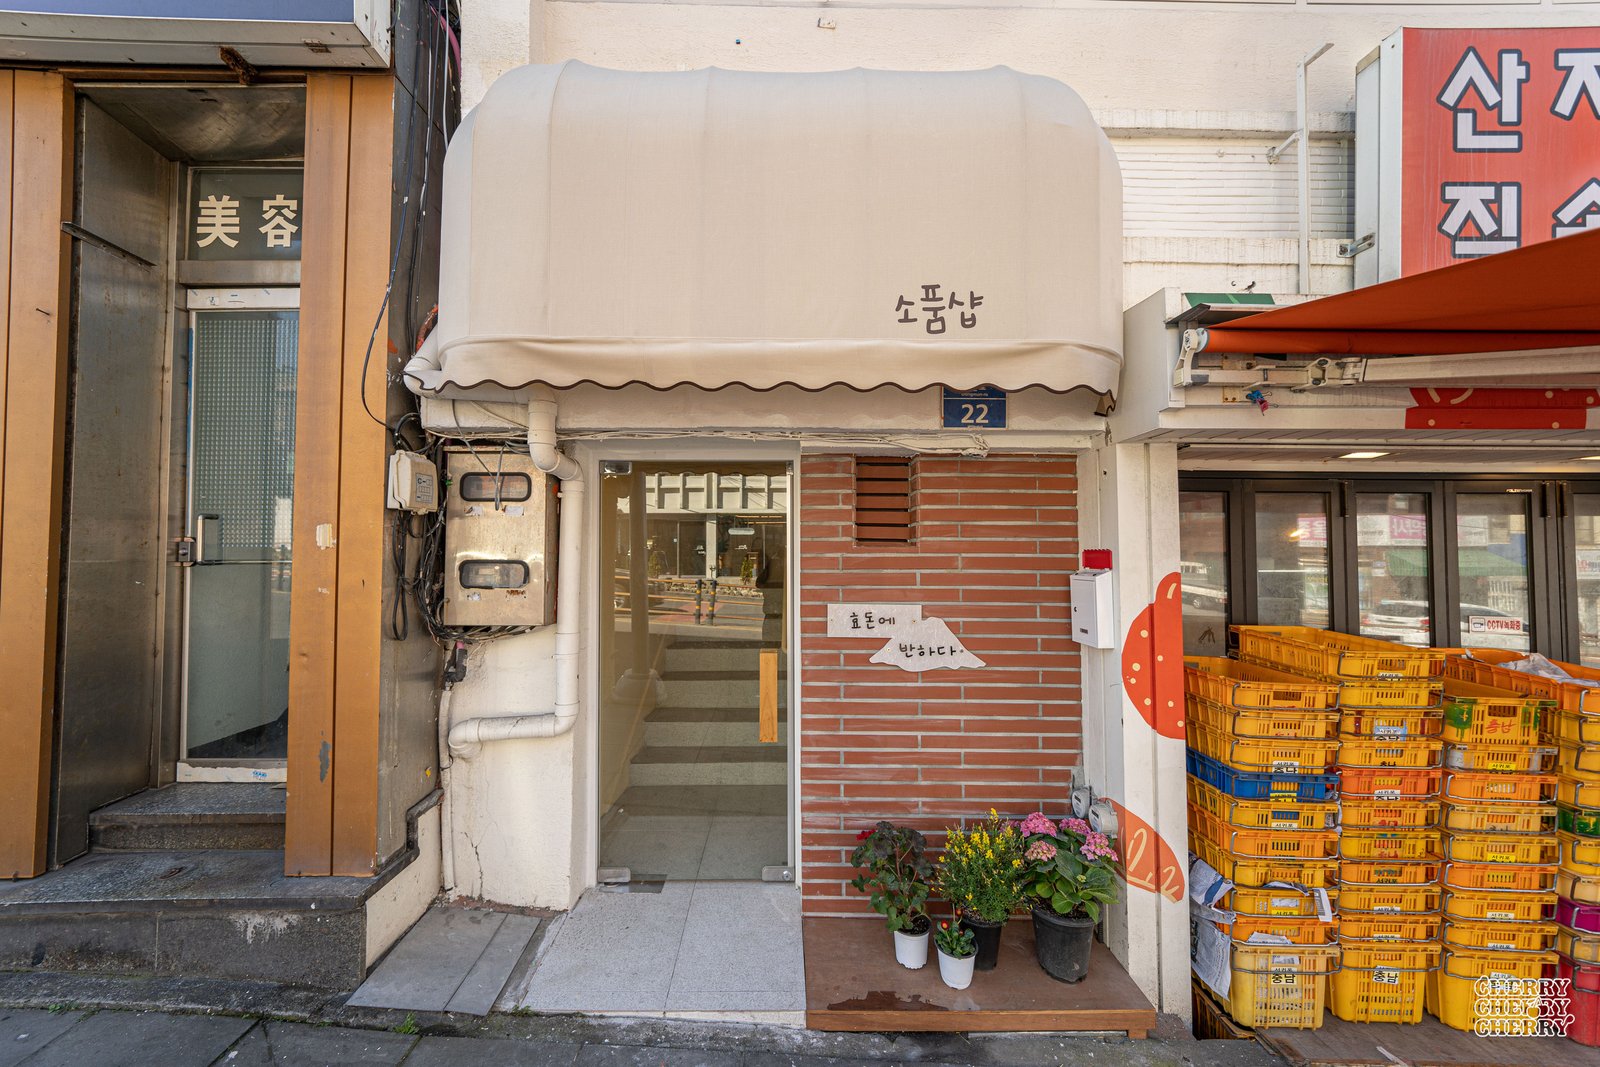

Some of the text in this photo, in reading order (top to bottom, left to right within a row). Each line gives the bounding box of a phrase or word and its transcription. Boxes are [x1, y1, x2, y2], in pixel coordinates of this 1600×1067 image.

[196, 194, 299, 249] 美容
[895, 284, 984, 335] 소품샵
[961, 403, 989, 424] 22
[850, 610, 896, 631] 효돈에
[1486, 617, 1522, 631] CCTV녹화중
